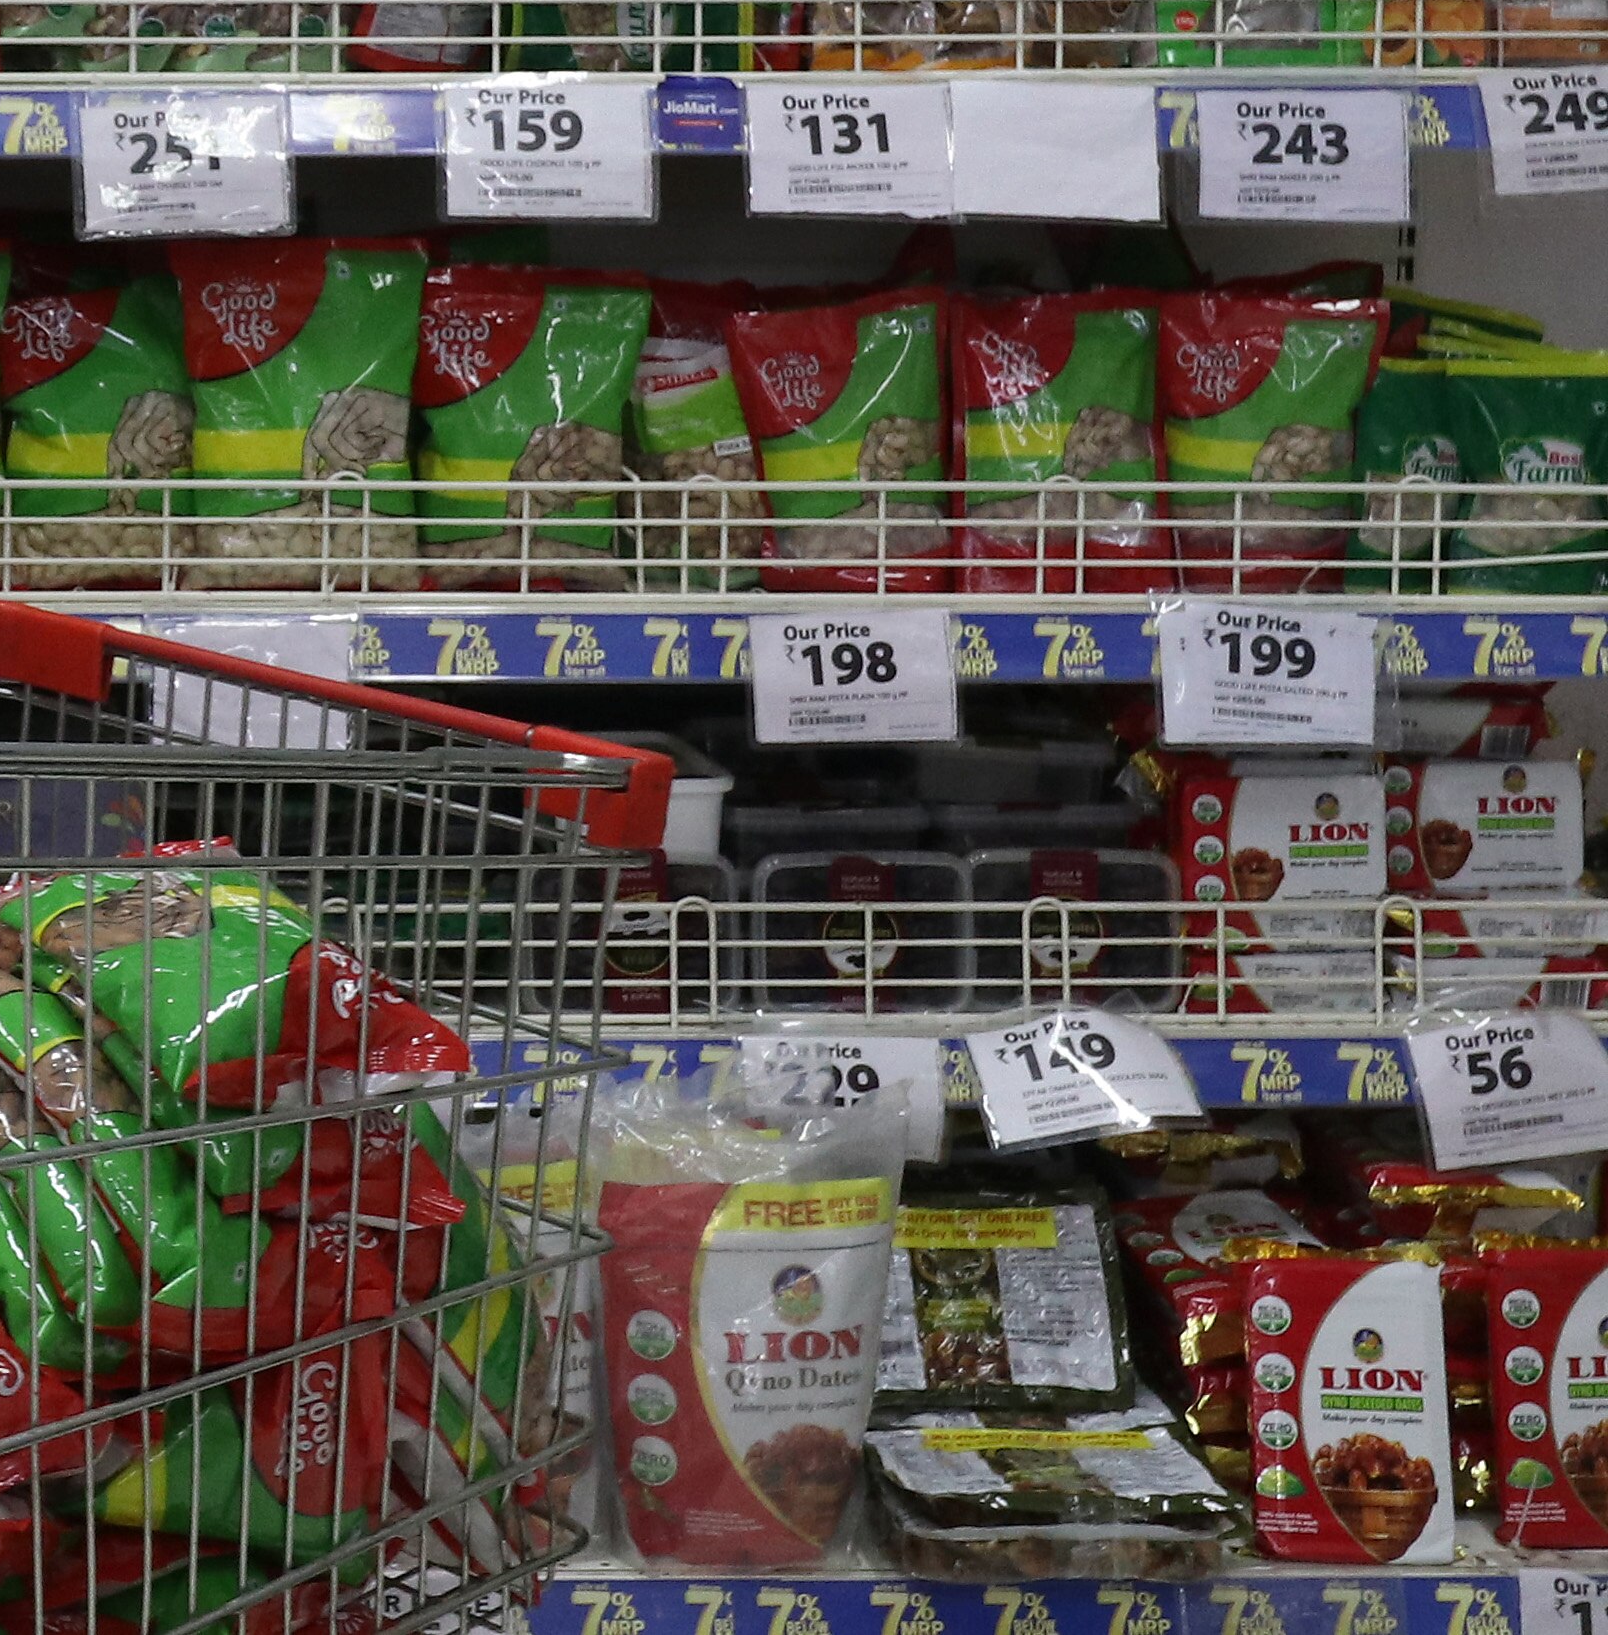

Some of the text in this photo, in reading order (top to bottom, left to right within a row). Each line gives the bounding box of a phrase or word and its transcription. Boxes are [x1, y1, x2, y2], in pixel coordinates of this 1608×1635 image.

[1512, 71, 1598, 90] Our Price
[479, 87, 566, 106] Our Price
[783, 92, 870, 110] Our Price
[114, 111, 146, 128] Our
[1237, 101, 1326, 119] Our Price
[759, 357, 820, 384] Good
[782, 380, 825, 409] Life
[784, 621, 871, 641] Our Price
[1217, 611, 1301, 633] Our Price
[1477, 796, 1558, 815] LION
[1288, 823, 1371, 843] LION
[1005, 1026, 1038, 1045] Our
[1445, 1026, 1535, 1052] Our Price
[743, 1199, 823, 1228] FREE
[723, 1324, 863, 1364] LION
[1319, 1367, 1424, 1391] LION
[1513, 1413, 1542, 1427] ZERO
